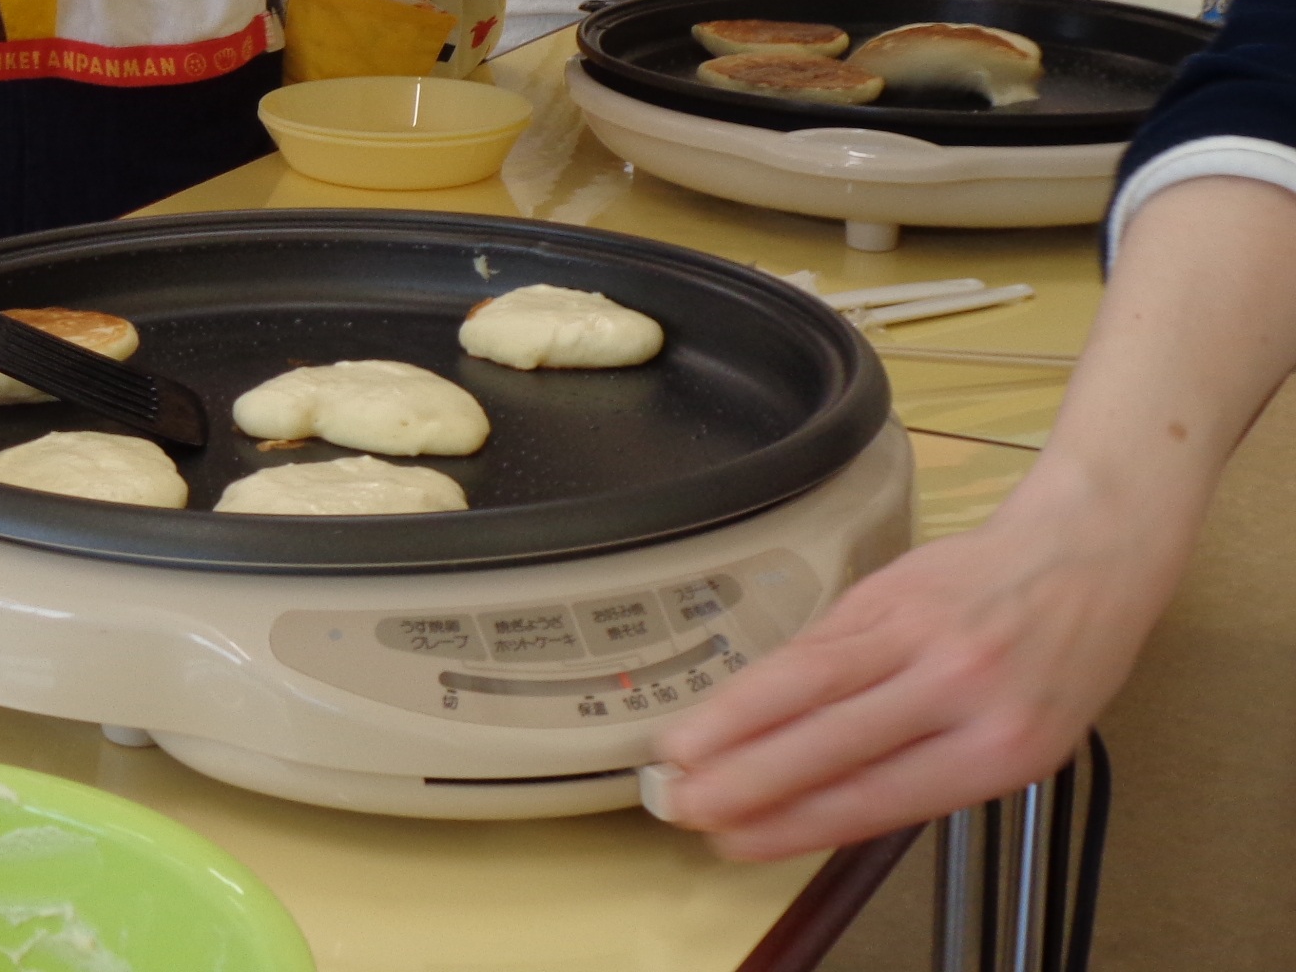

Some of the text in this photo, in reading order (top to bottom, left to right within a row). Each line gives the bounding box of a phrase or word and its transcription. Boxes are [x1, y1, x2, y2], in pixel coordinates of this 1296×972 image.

[47, 50, 176, 78] ANPANMAN
[686, 671, 714, 693] 200
[622, 693, 649, 711] 160
[653, 685, 679, 705] 180
